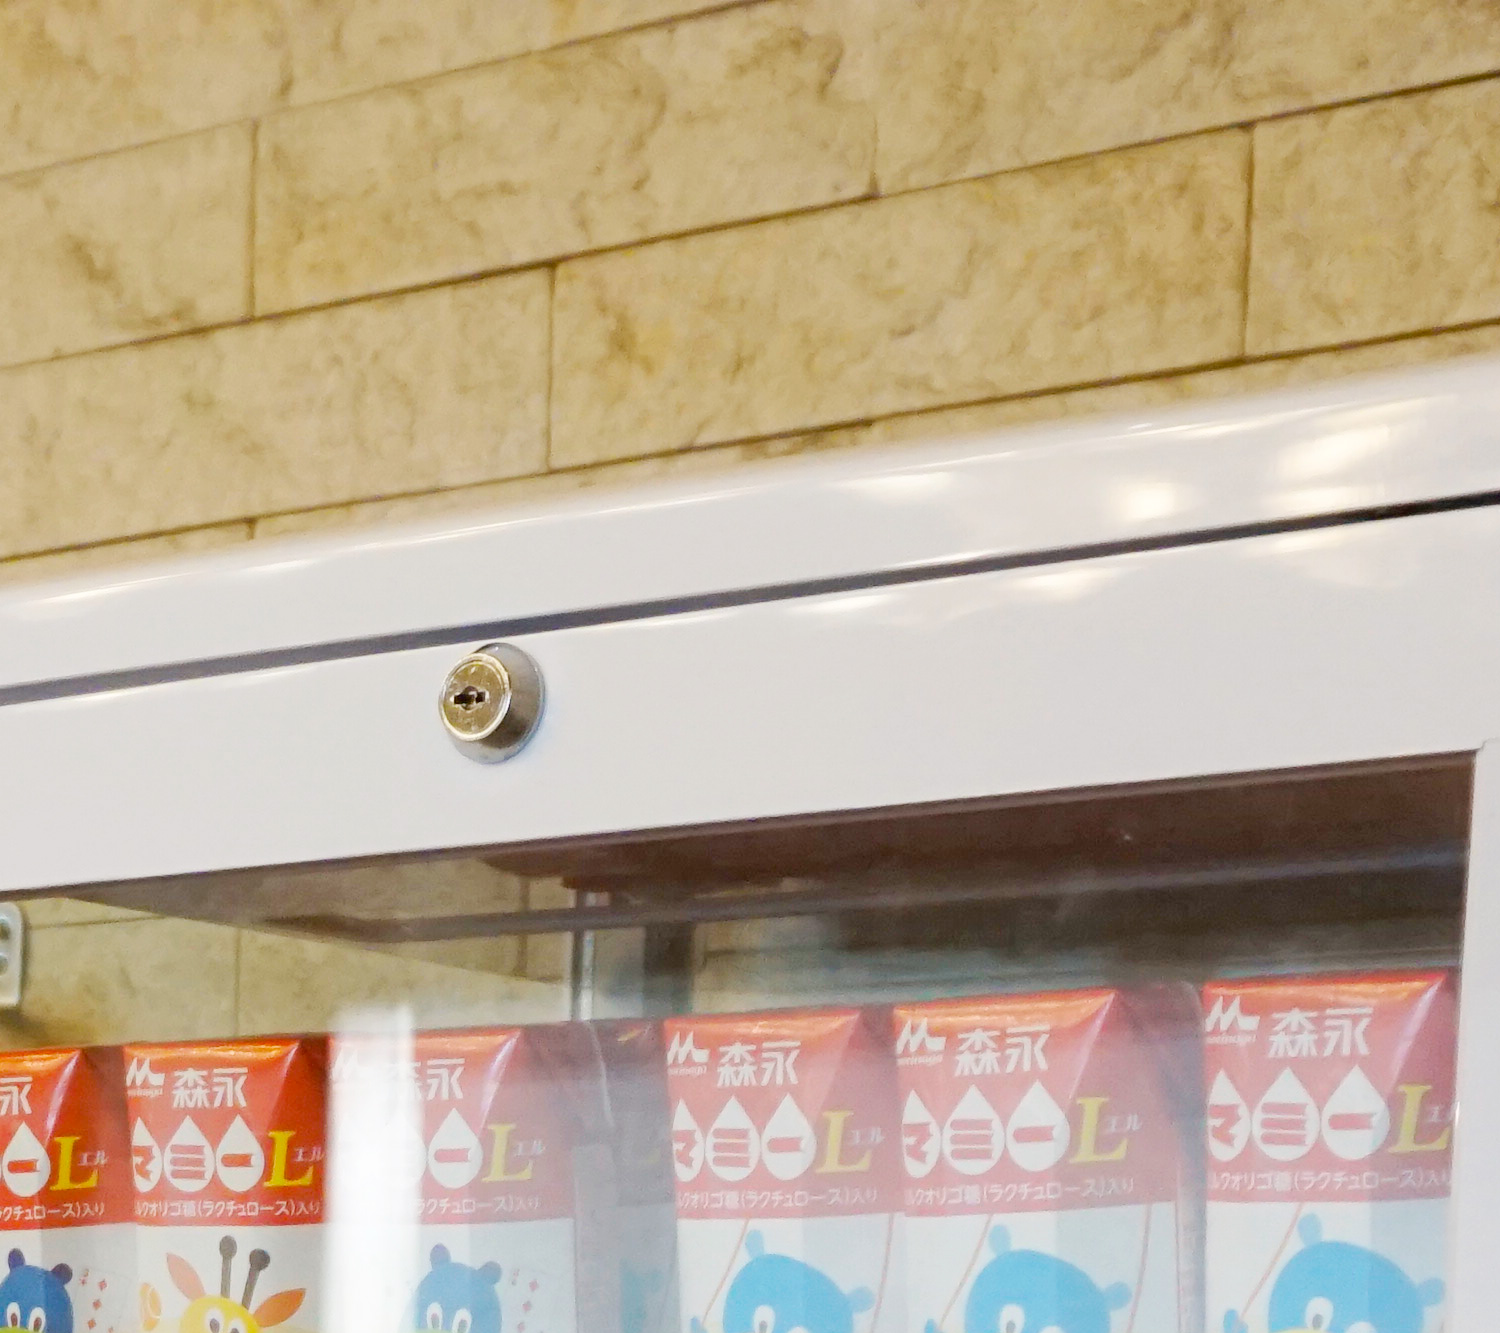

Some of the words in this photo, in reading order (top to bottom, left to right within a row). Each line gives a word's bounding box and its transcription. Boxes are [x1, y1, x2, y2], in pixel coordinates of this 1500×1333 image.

[954, 1025, 1049, 1077] 森永
[1268, 1007, 1374, 1058] 森永
[172, 1067, 248, 1108] 森永
[717, 1041, 801, 1088] 森永
[816, 1110, 872, 1174] L
[1069, 1096, 1128, 1164] L
[1388, 1084, 1449, 1154] L
[50, 1136, 98, 1191] L
[263, 1130, 314, 1187] L
[482, 1123, 533, 1182] L
